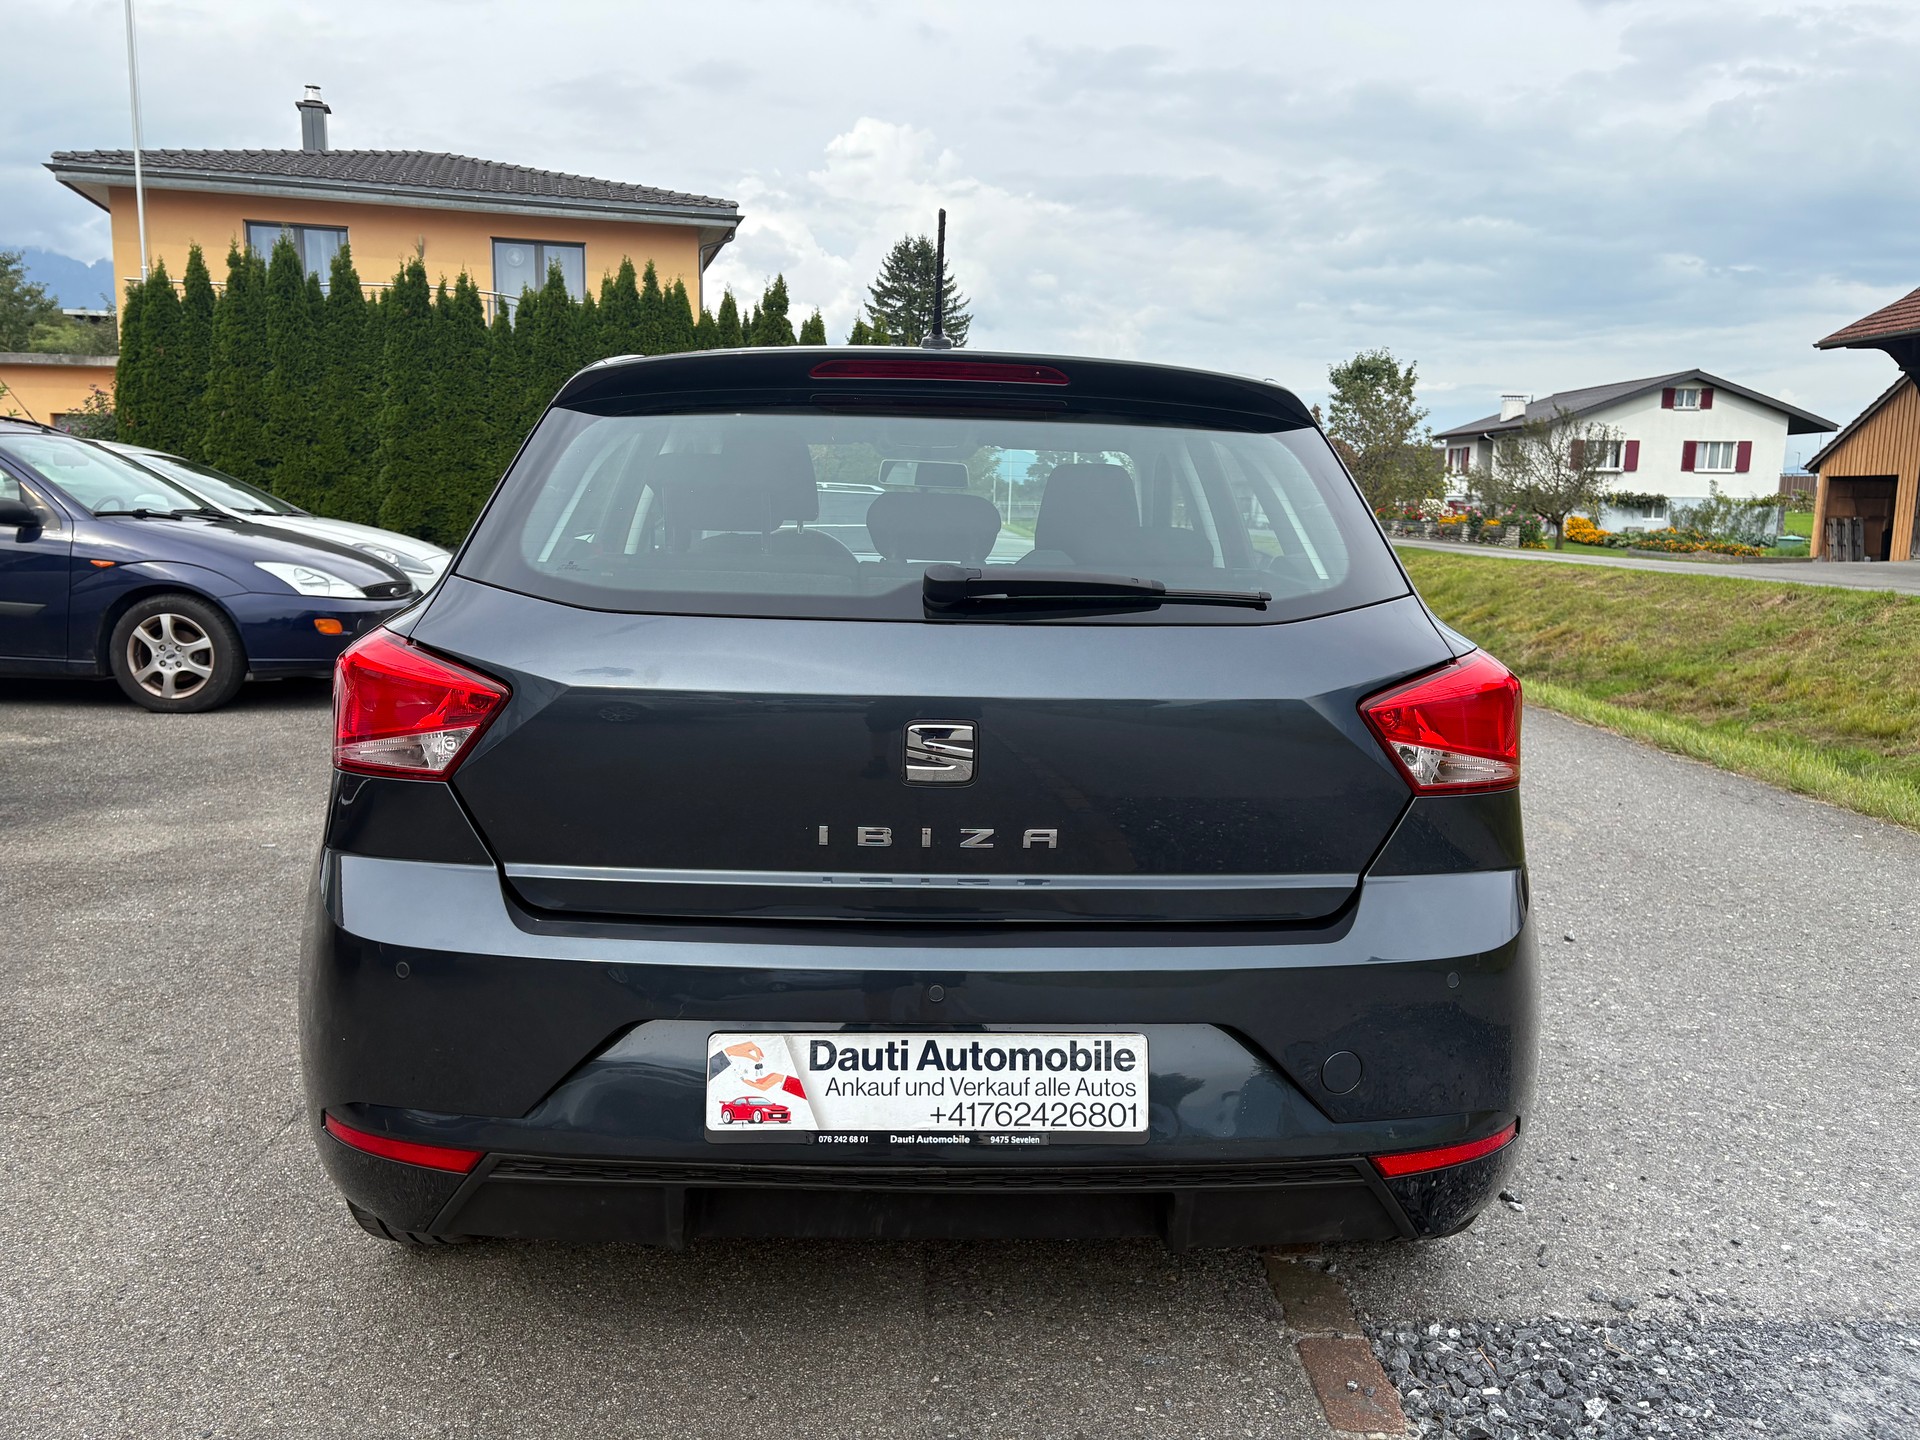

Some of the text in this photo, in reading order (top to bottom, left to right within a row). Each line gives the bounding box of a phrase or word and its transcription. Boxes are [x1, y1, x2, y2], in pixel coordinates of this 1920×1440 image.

[818, 825, 1058, 849] IBIZA
[809, 1039, 1136, 1072] Dauti Automobile
[825, 1076, 1137, 1097] Ankauf und Verkauf alle Autos
[929, 1101, 1137, 1128] +41762426801
[818, 1135, 869, 1144] 076 242 68 01
[890, 1135, 971, 1144] Dauti Automobile
[990, 1135, 1040, 1144] 9475 Sevelen
